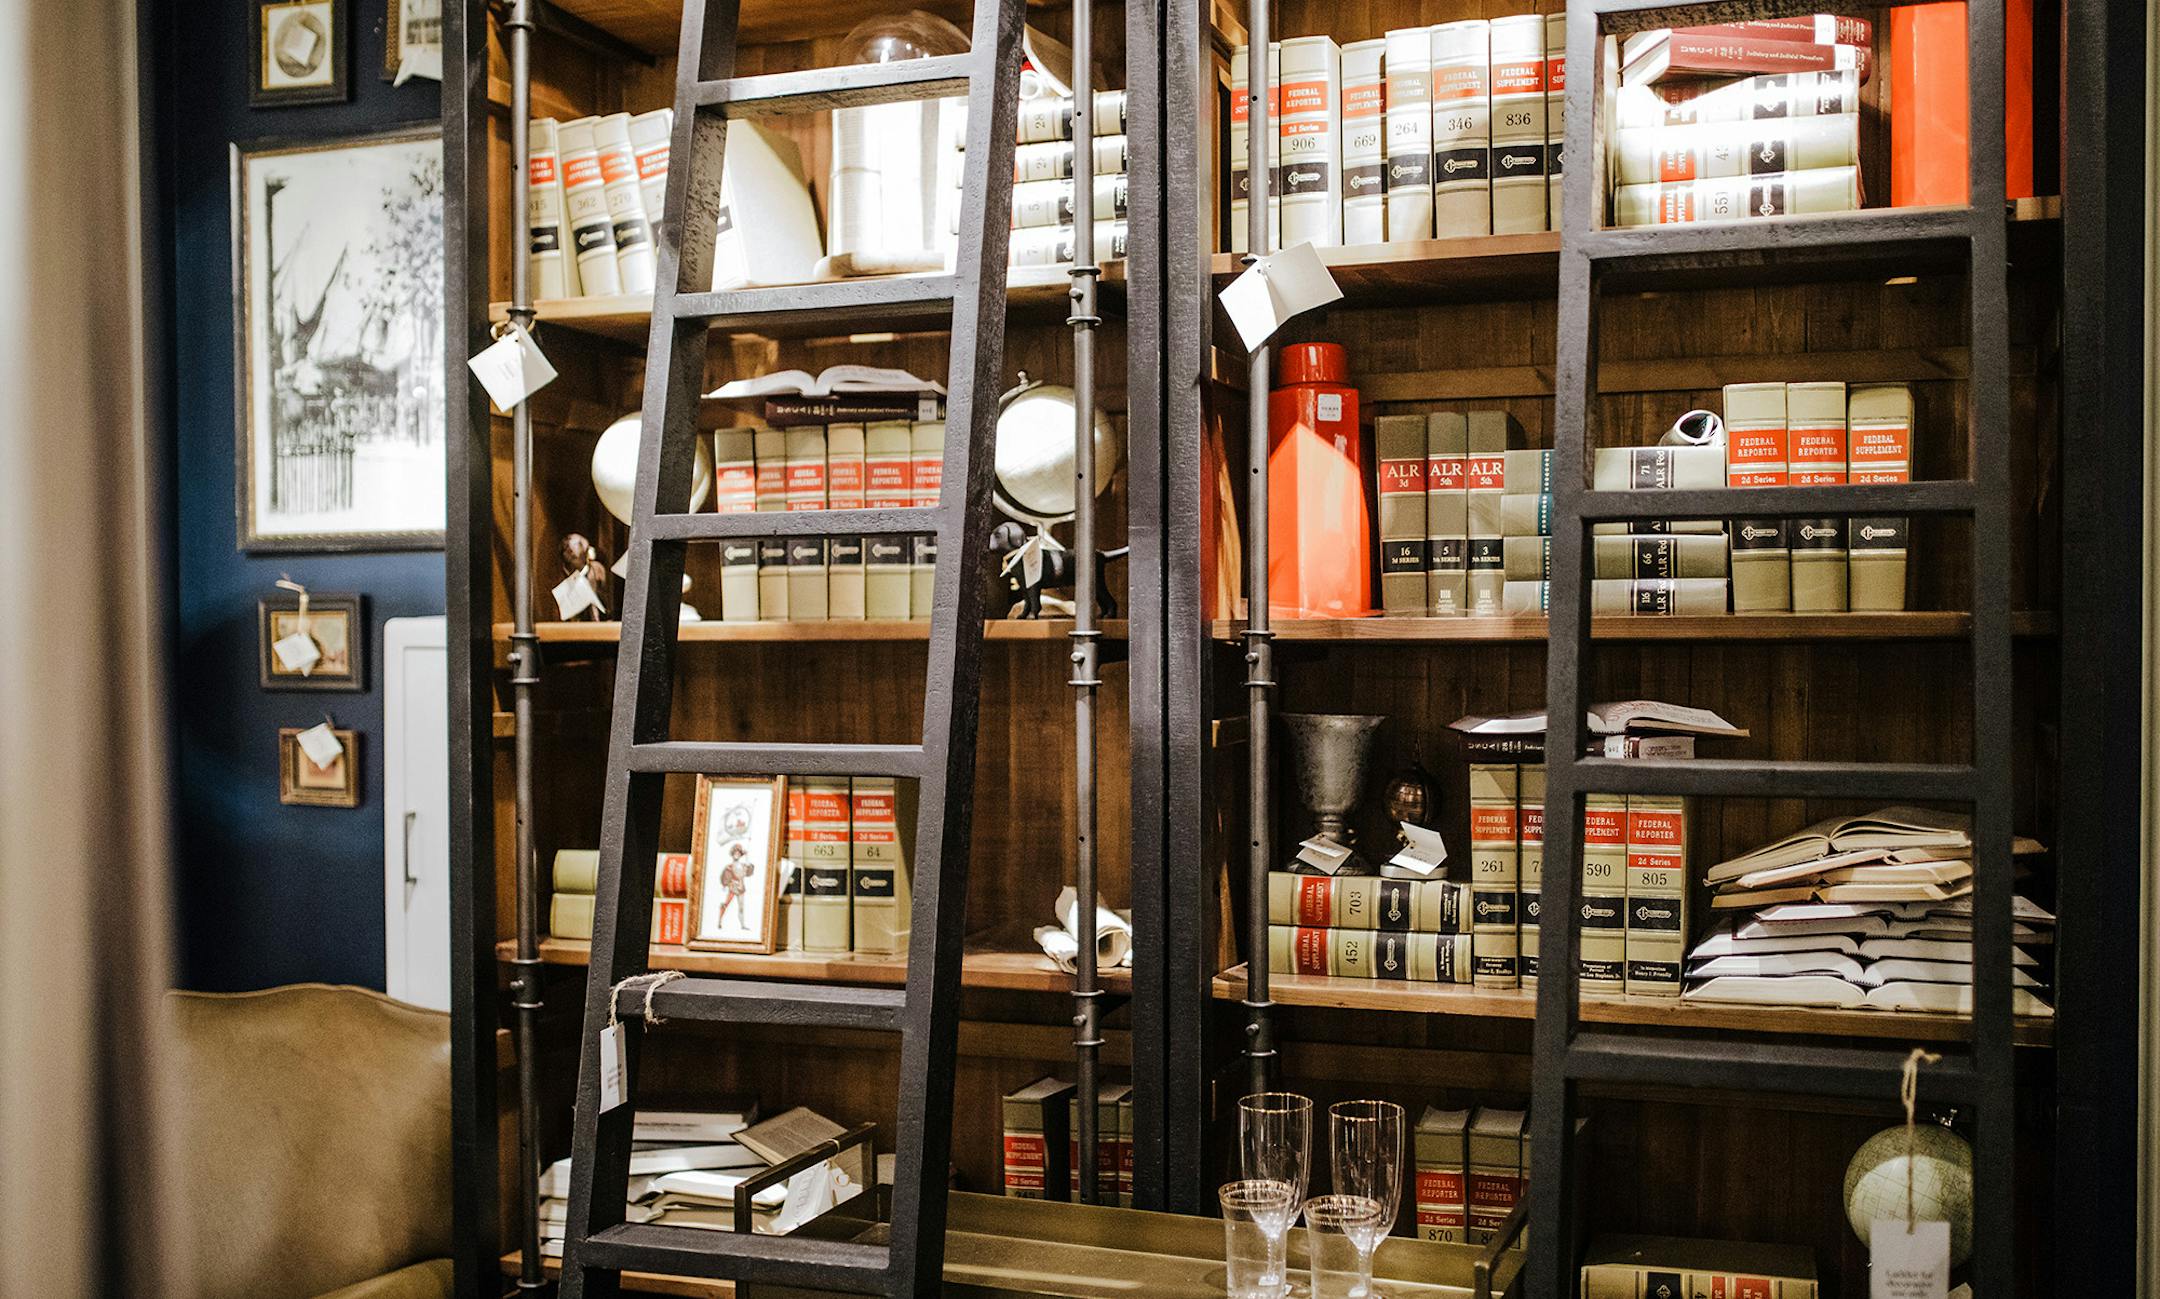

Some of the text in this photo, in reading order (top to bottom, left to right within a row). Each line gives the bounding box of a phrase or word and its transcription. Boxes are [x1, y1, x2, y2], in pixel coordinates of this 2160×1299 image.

[1501, 67, 1535, 77] FEDERAL
[1497, 77, 1539, 88] SUPPLEMENT
[1288, 88, 1319, 98] FEDERAL
[1448, 116, 1473, 131] 346
[1505, 113, 1531, 127] 836
[1395, 121, 1418, 136] 264
[1291, 137, 1316, 151] 906
[1353, 135, 1377, 148] 669
[1740, 437, 1775, 447] FEDERAL
[1800, 436, 1835, 446] FEDERAL
[1863, 434, 1895, 444] FEDERAL
[1737, 447, 1778, 457] REPORTER
[1798, 447, 1838, 457] REPORTER
[1855, 444, 1903, 455] SUPPLEMENT
[1386, 464, 1420, 478] ALR
[1430, 462, 1463, 476] ALR
[1470, 461, 1503, 476] ALR
[1640, 464, 1650, 476] 71
[1655, 450, 1665, 488] ALR Fed
[1398, 479, 1408, 488] 3d
[1440, 477, 1452, 486] 5th
[1480, 476, 1492, 486] 5th
[1741, 475, 1776, 484] 2d Series
[1801, 474, 1836, 484] 2d Series
[1860, 474, 1899, 483] 2d Series
[1400, 547, 1410, 557] 16
[1442, 545, 1449, 555] 5
[1482, 545, 1489, 555] 3
[1642, 552, 1652, 565] 66
[1657, 539, 1668, 578] ALR Fed
[1640, 591, 1650, 604] 116
[1478, 815, 1508, 824] FEDERAL
[1585, 817, 1616, 826] EDERAL
[1638, 819, 1672, 829] FEDERAL
[1475, 826, 1511, 834] SUPPLEMENT
[1585, 827, 1620, 837] PPLEMENT
[1636, 830, 1674, 839] REPORTER
[813, 845, 834, 857] 663
[867, 846, 881, 857] 64
[1481, 860, 1505, 872] 261
[1638, 857, 1671, 866] 2d Series
[1586, 863, 1611, 877] 590
[1641, 872, 1668, 886] 805
[1306, 884, 1315, 917] FEDERAL
[1315, 881, 1325, 922] SUPPLEMENT
[1349, 890, 1362, 916] 703
[1302, 933, 1311, 966] FEDERAL
[1311, 929, 1321, 970] SUPPLEMENT
[1345, 941, 1358, 966] 452
[1020, 1178, 1039, 1186] Series
[1423, 1179, 1456, 1189] FEDERAL
[1477, 1182, 1511, 1191] FEDERAL
[1422, 1189, 1459, 1199] REPORTER
[1436, 1216, 1456, 1225] Series
[1428, 1229, 1453, 1242] 870
